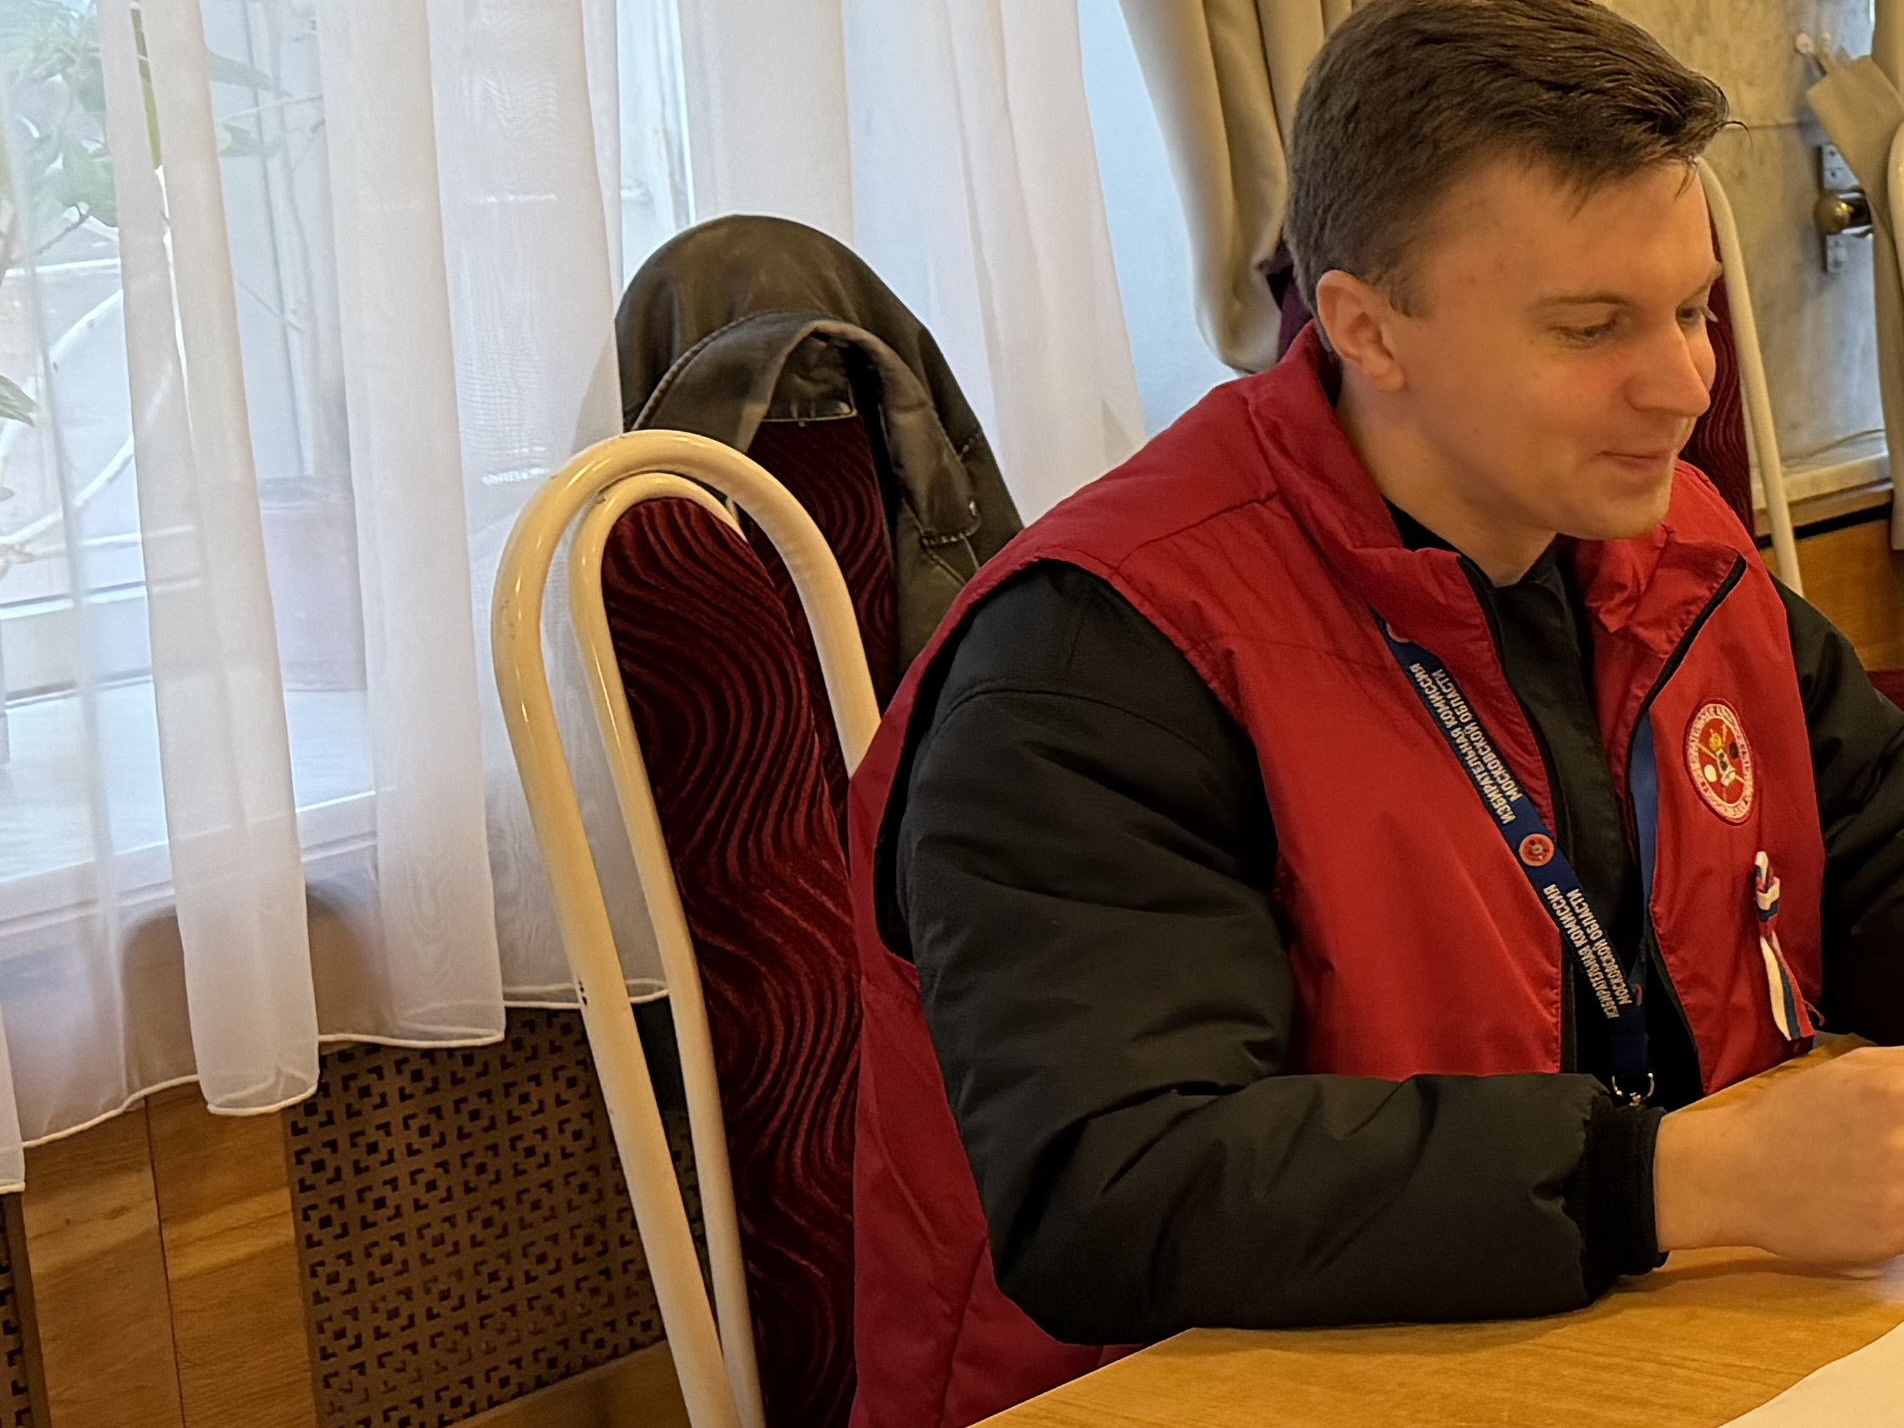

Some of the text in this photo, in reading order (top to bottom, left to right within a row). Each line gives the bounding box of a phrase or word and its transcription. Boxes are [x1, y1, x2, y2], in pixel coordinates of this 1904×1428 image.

[1409, 663, 1517, 824] ИЗБИРАТЕЛЬНАЯ КОМИССИЯ
[1431, 668, 1523, 802] МОСКОВСКОЙ ОБЛАСТИ
[1543, 883, 1588, 948] КОМИССИЯ
[1566, 888, 1603, 941] ОБЛАСТИ
